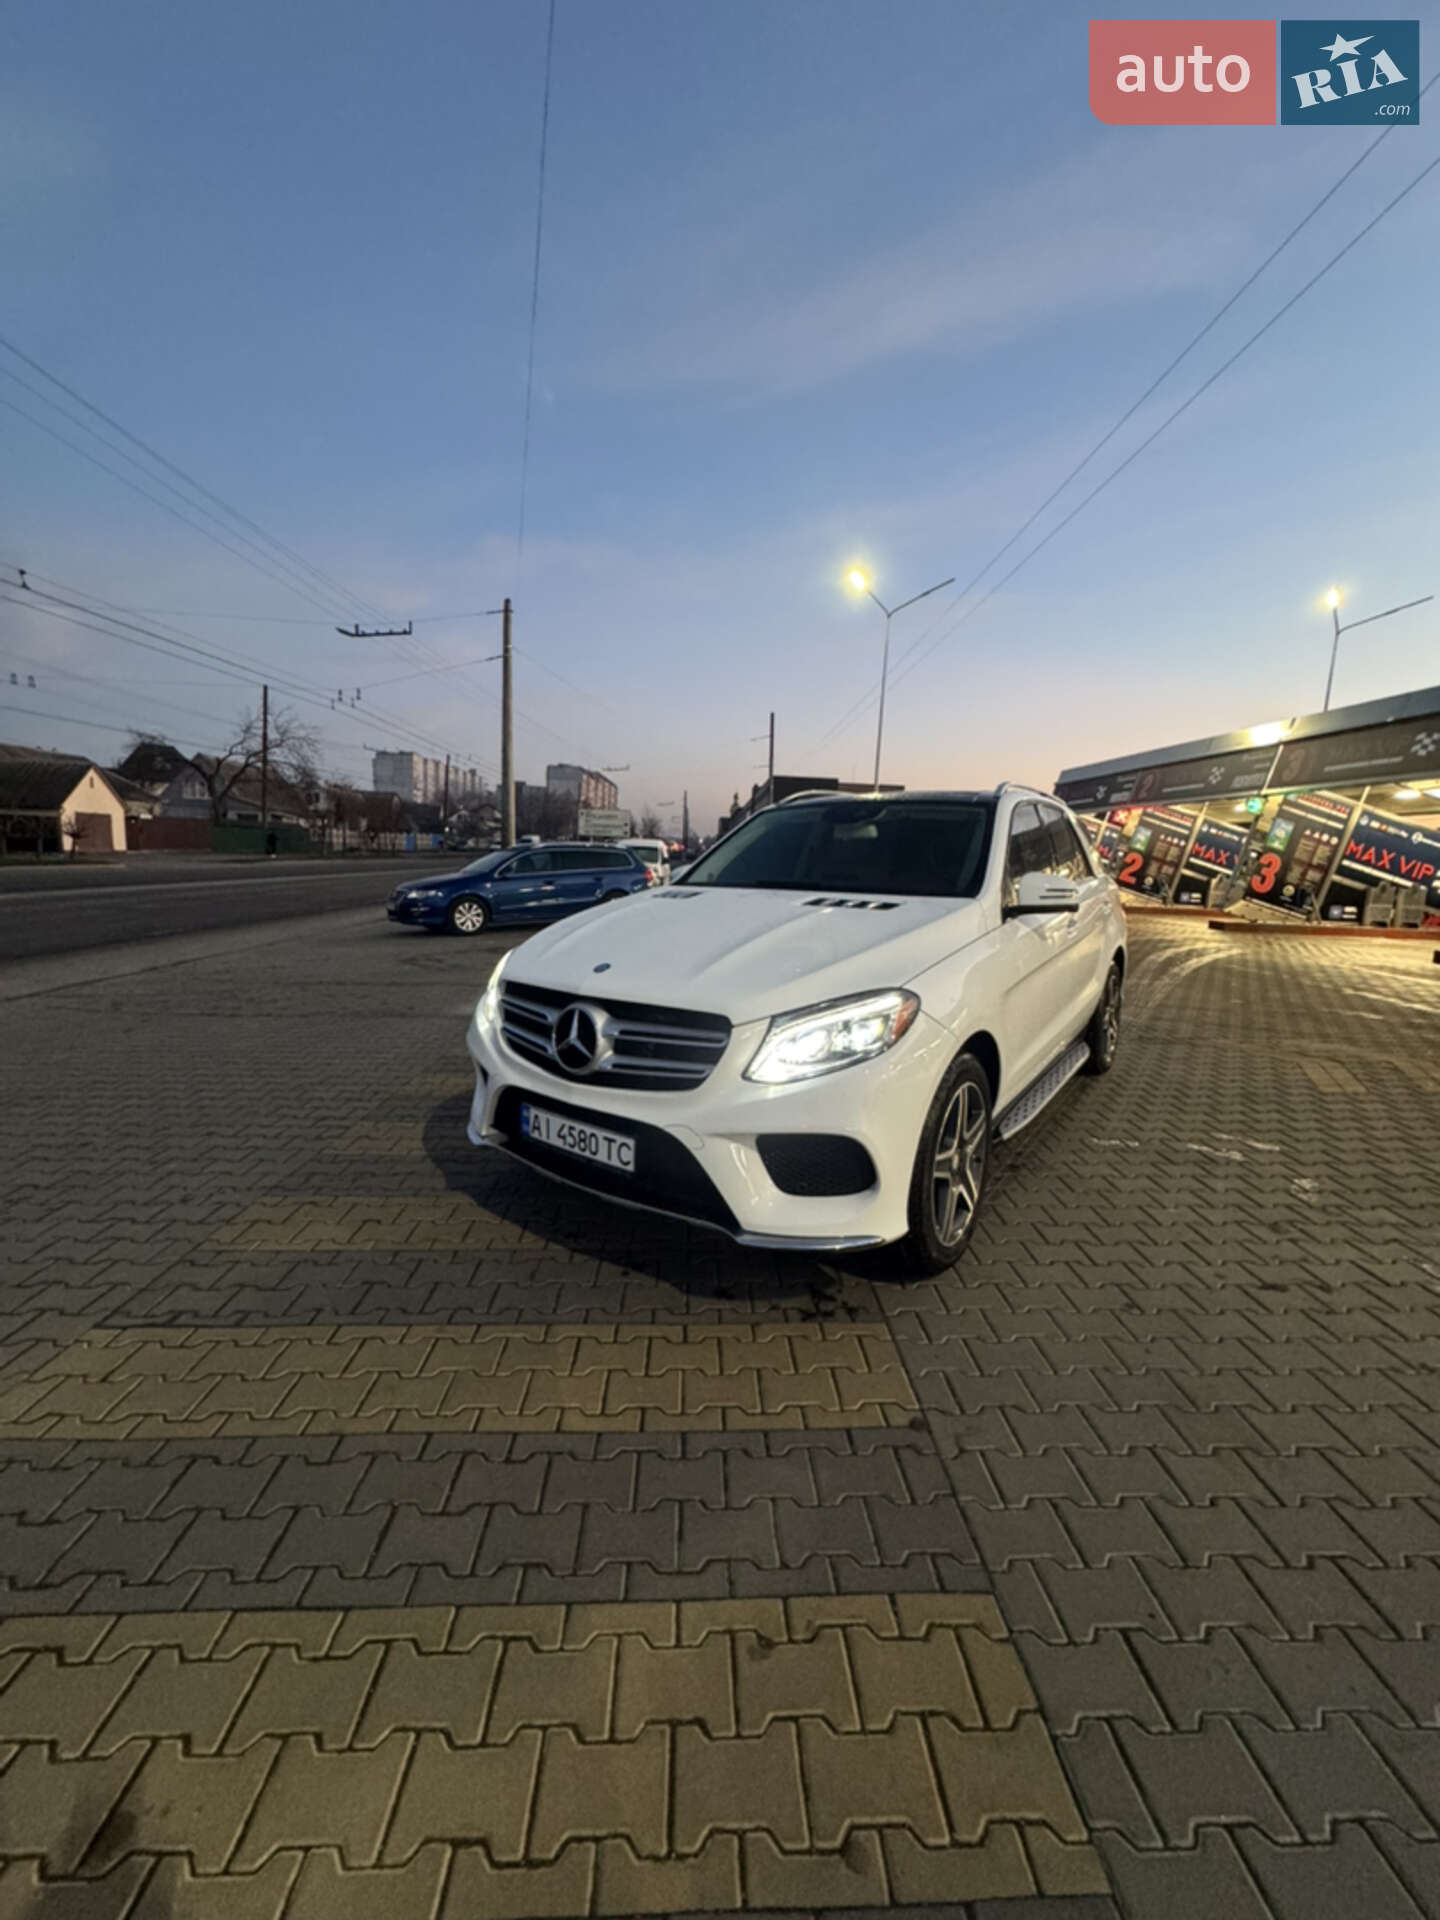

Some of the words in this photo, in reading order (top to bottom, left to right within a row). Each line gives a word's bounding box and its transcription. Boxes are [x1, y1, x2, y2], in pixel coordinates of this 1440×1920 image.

[1118, 851, 1144, 885] 2
[1191, 842, 1231, 866] MAX
[1251, 852, 1282, 894] 3
[1345, 839, 1396, 871] MAX
[1399, 855, 1435, 880] VIP
[531, 1113, 551, 1140] AI
[556, 1122, 600, 1157] 4580
[602, 1136, 632, 1167] TC
